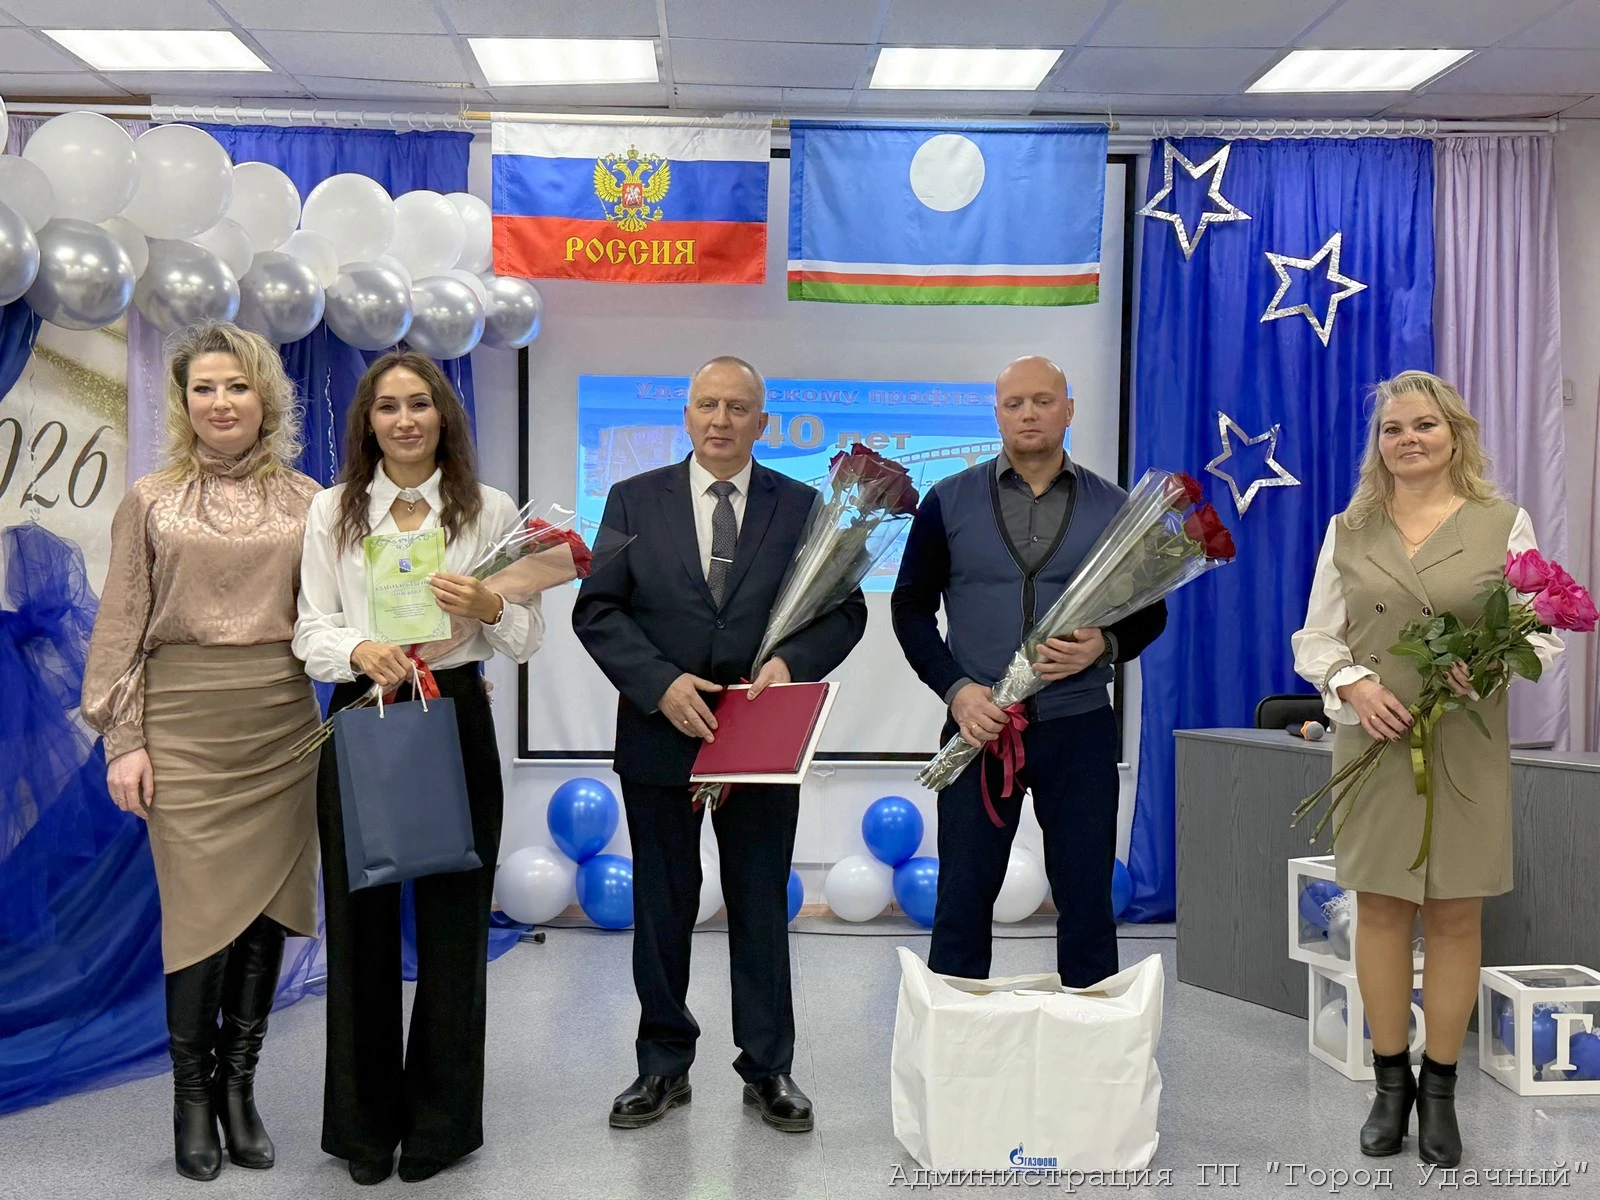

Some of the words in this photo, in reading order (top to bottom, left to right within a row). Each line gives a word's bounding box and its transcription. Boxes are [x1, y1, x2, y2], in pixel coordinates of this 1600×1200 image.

[563, 236, 696, 266] РОССИЯ
[758, 413, 825, 449] 40
[835, 431, 912, 450] лет
